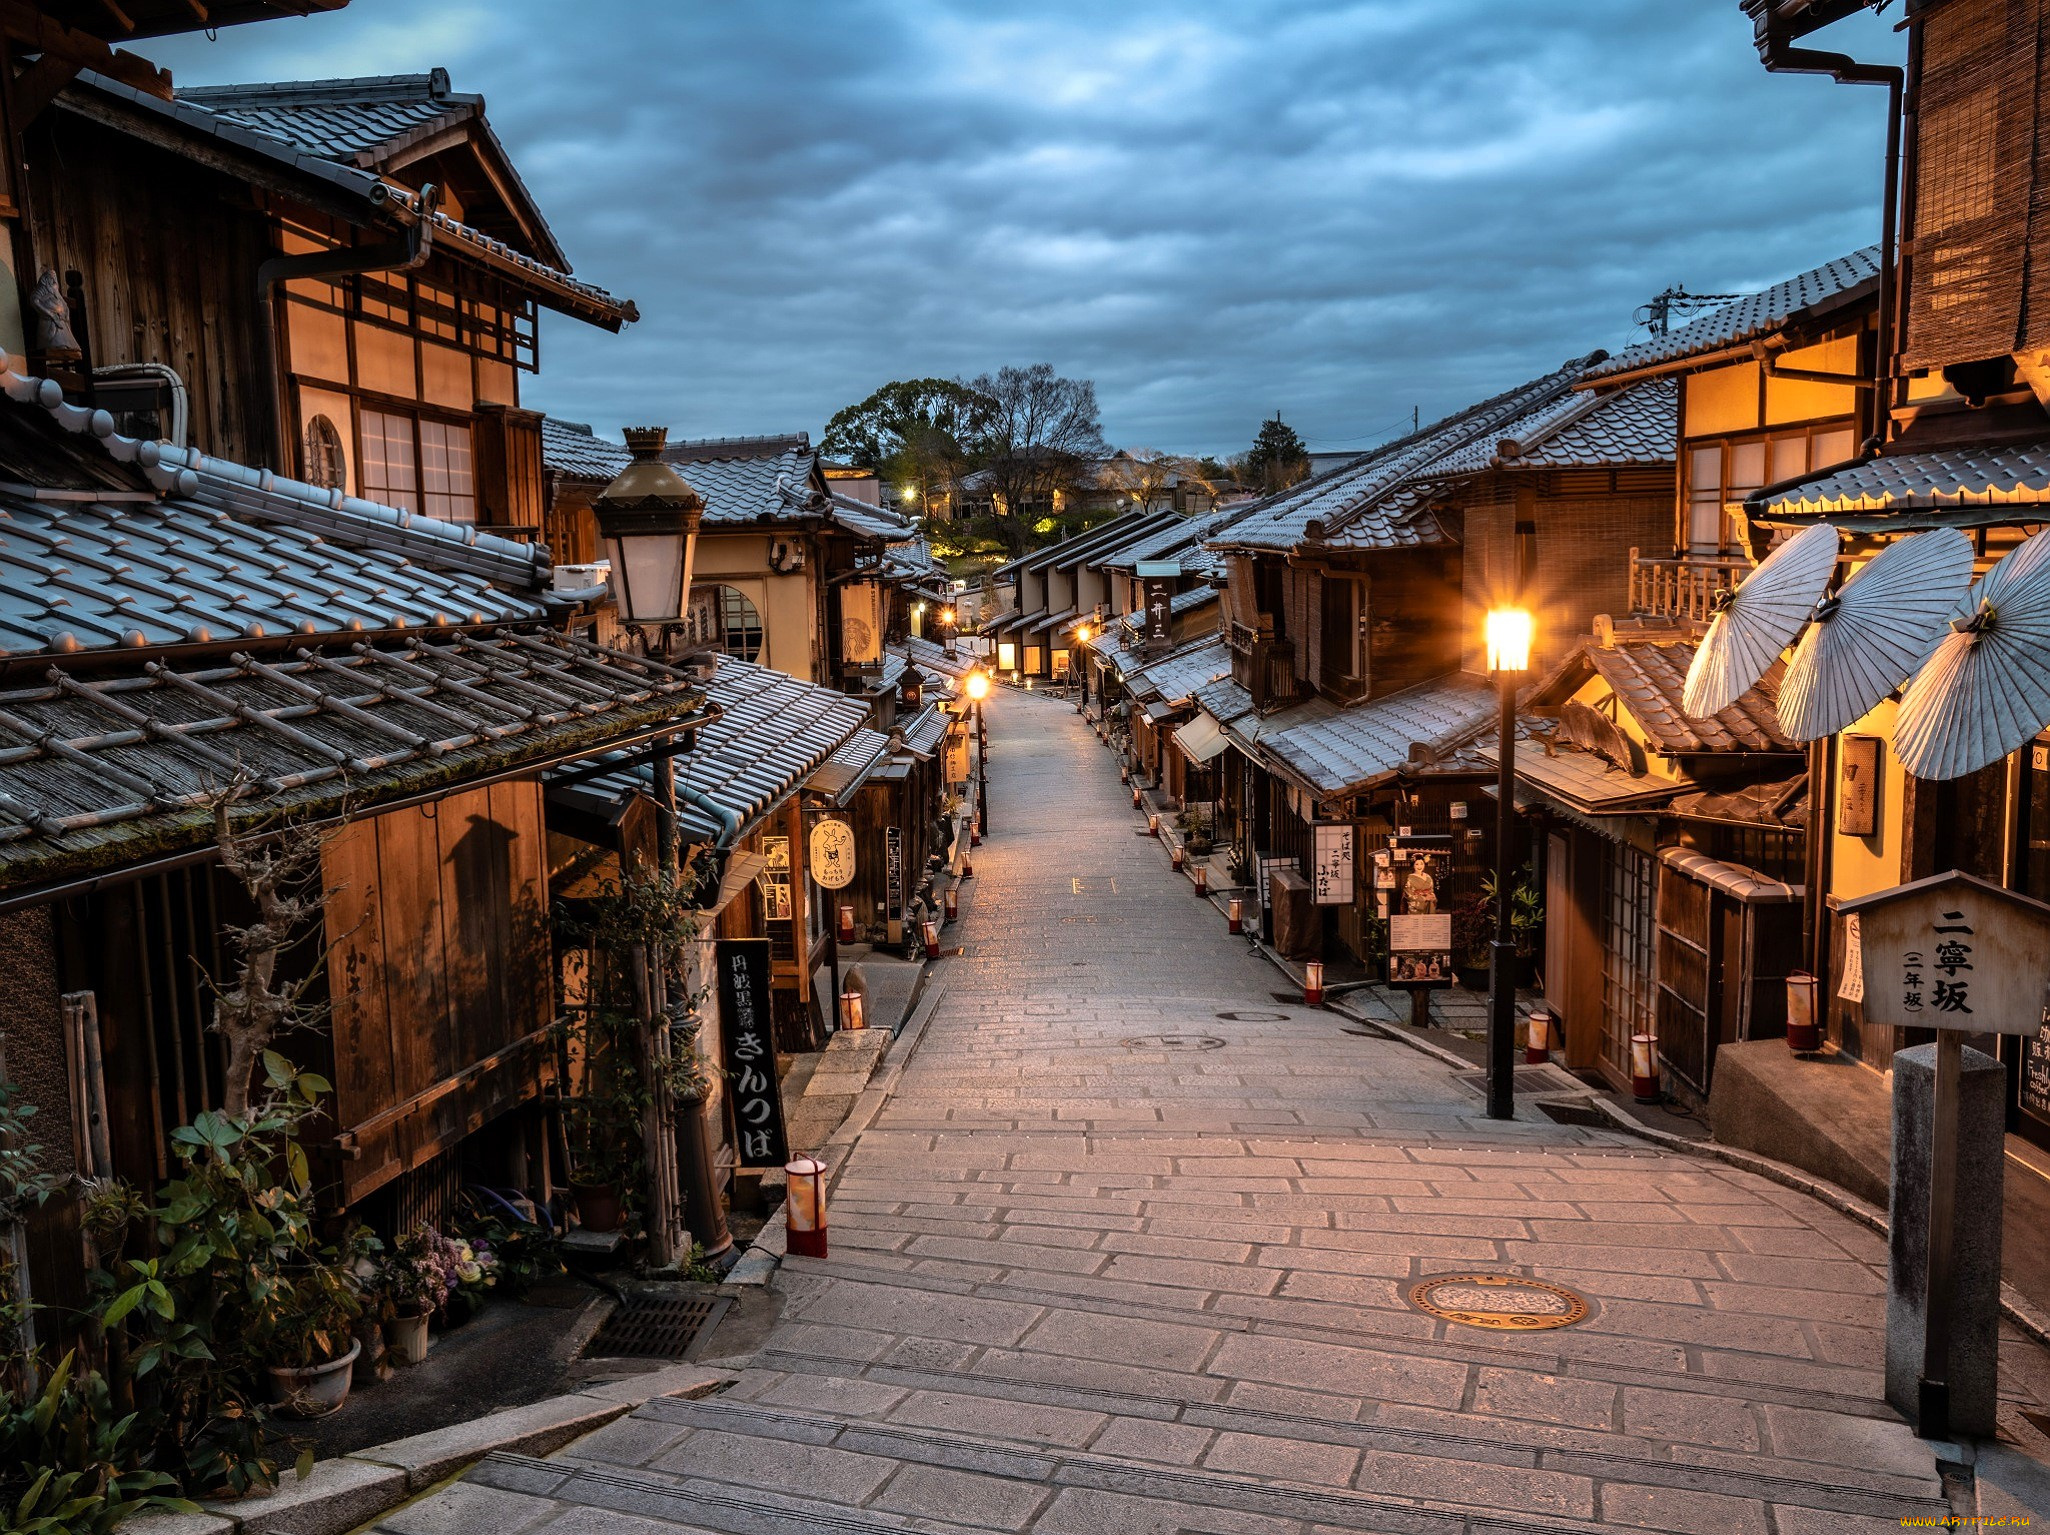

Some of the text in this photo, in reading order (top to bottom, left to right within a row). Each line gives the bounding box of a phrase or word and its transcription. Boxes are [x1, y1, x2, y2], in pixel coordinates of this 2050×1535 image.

[1150, 584, 1167, 638] 二井三
[1341, 832, 1351, 861] そば処
[1318, 865, 1331, 896] ふたば
[1903, 951, 1924, 1012] （二年坂）
[1931, 911, 1974, 1013] 二寧坂
[734, 1031, 773, 1158] きんつば
